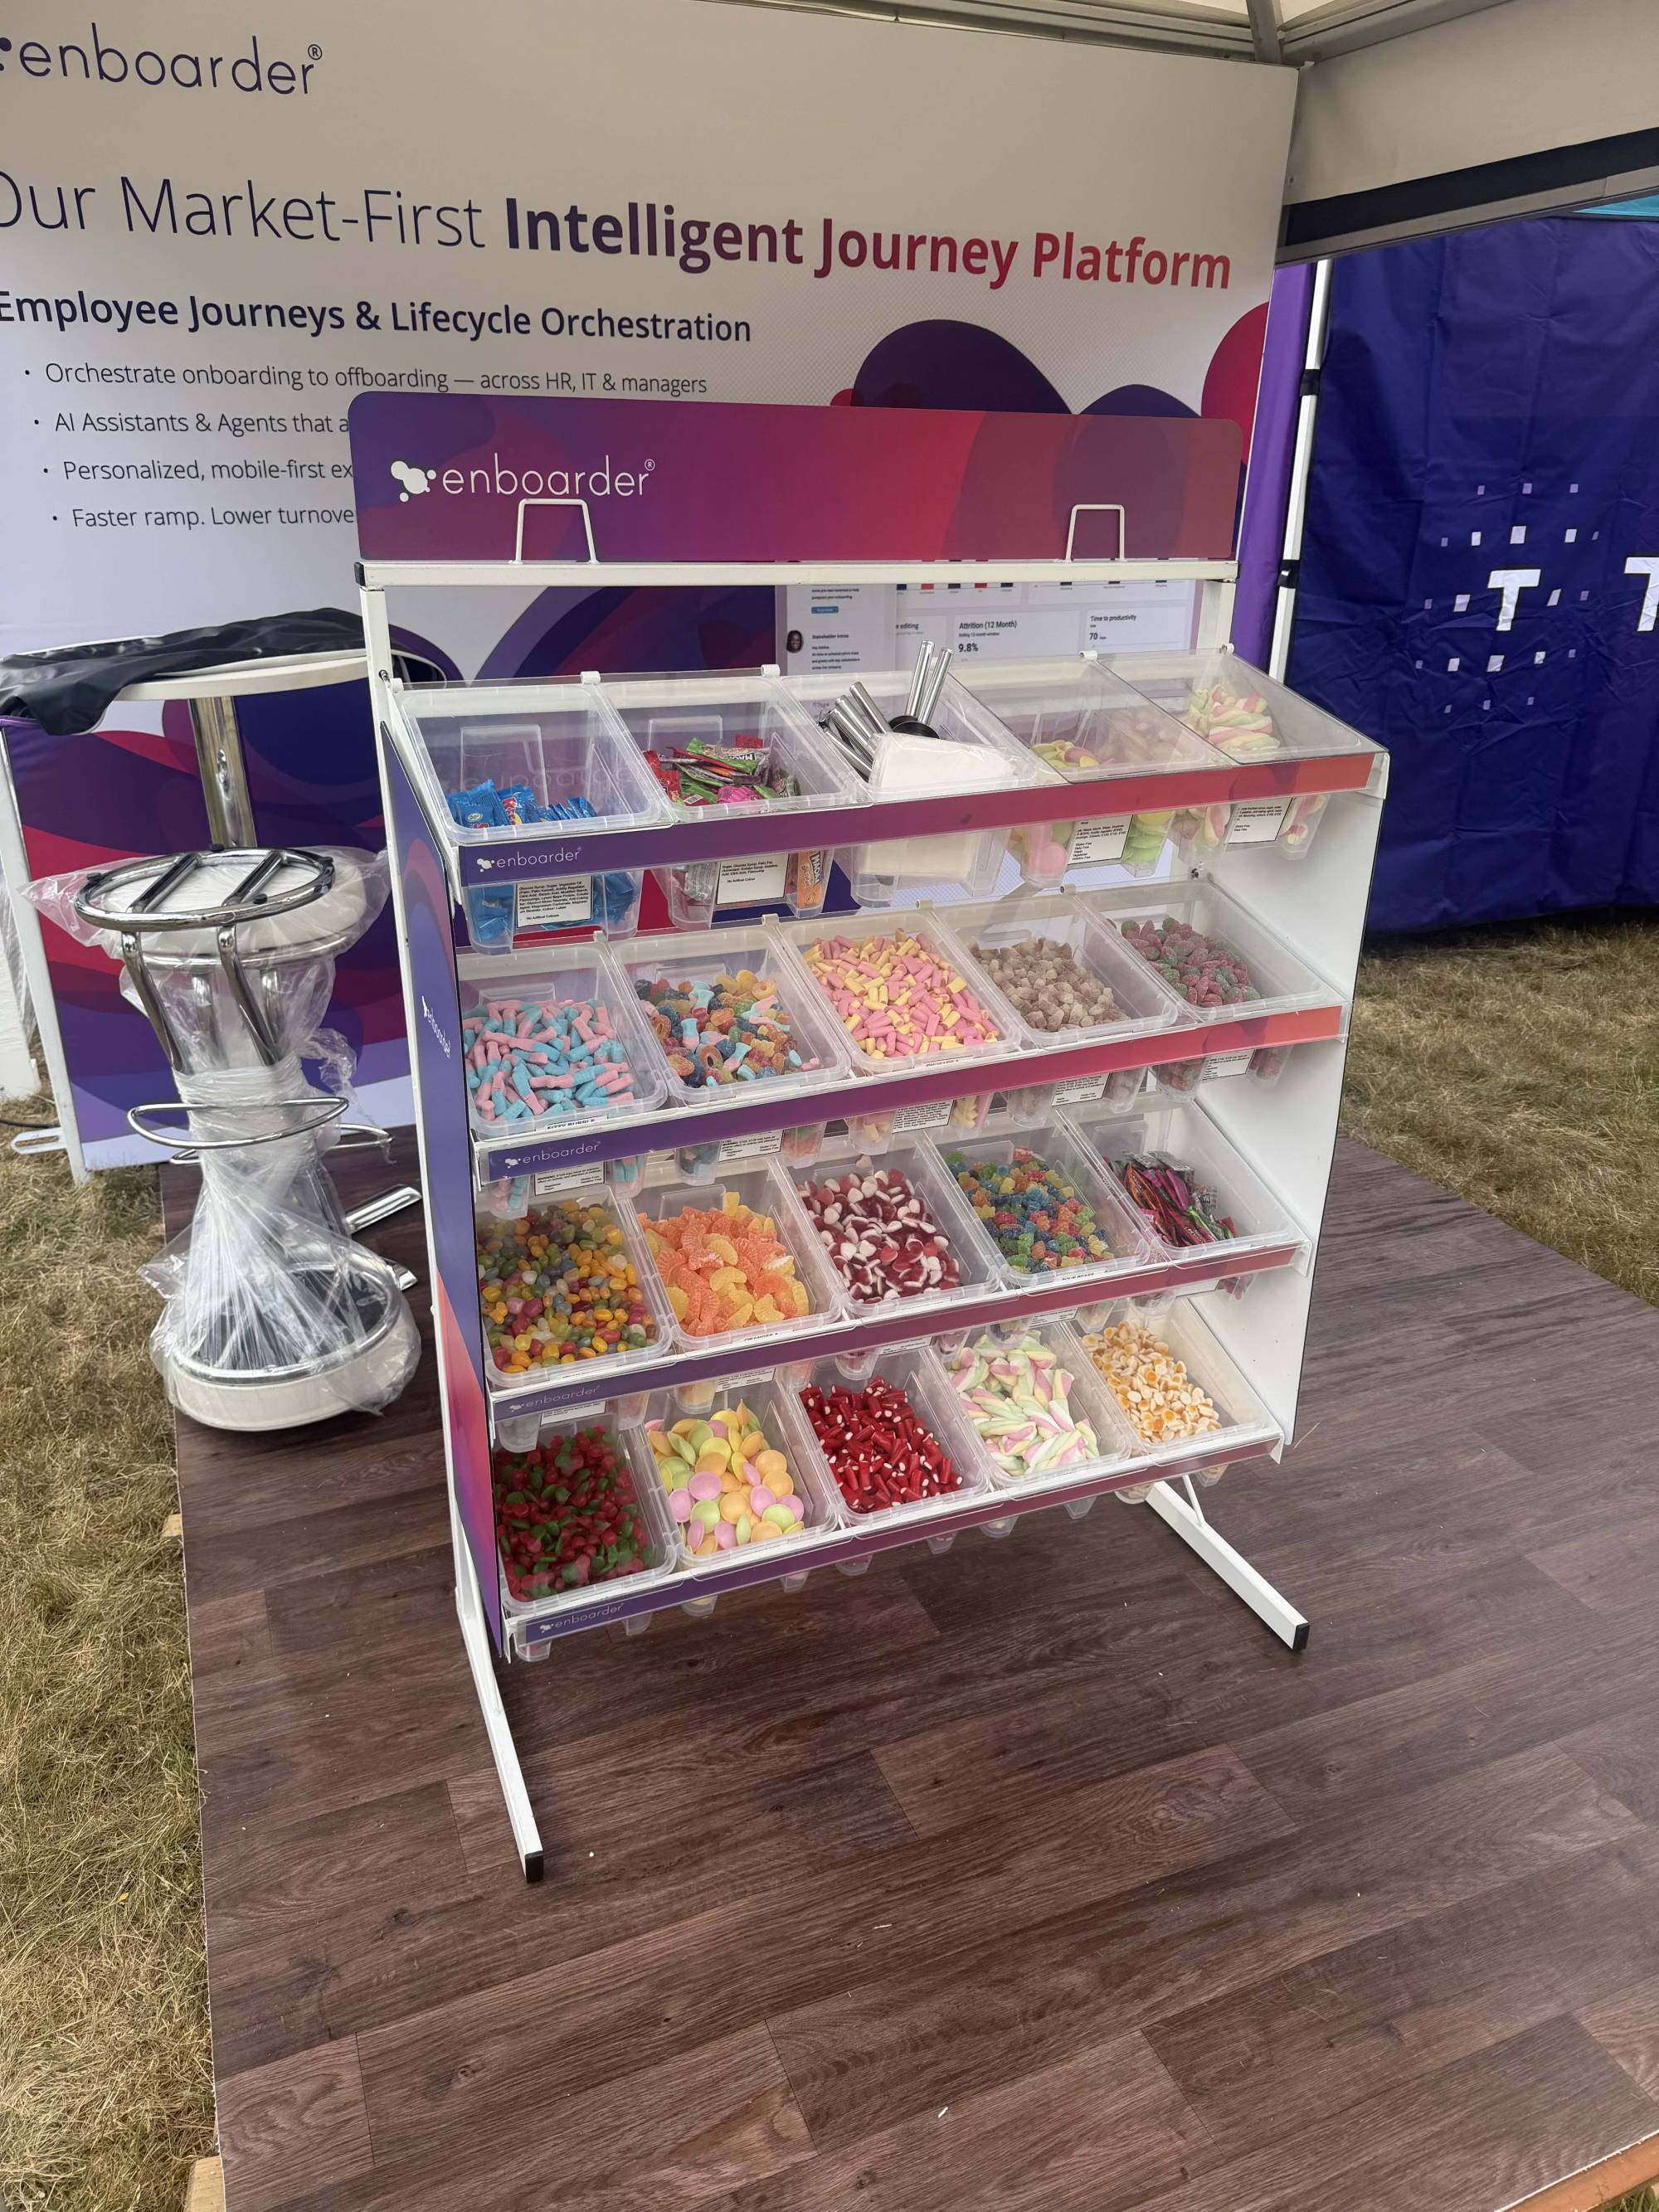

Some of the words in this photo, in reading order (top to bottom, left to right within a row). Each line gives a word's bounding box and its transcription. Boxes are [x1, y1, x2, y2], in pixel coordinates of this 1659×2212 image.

[120, 176, 487, 248] Market-First
[505, 197, 804, 275] Intelligent
[814, 217, 1019, 289] Journey
[1033, 232, 1231, 289] Platform
[0, 291, 179, 333] Employee
[188, 295, 345, 338] Journeys
[355, 300, 382, 330] &
[391, 302, 531, 341] Lifecycle
[541, 307, 752, 342] Orchestration
[46, 362, 176, 384] Orchestrate
[182, 364, 304, 391] onboarding
[308, 370, 328, 387] to
[335, 367, 449, 392] offboarding
[480, 373, 540, 390] across
[546, 372, 576, 392] HR,
[581, 373, 597, 391] IT
[602, 373, 617, 391] &
[622, 376, 708, 397] managers
[55, 413, 75, 432] AI
[82, 412, 188, 432] Assistants
[195, 414, 211, 432] &
[217, 414, 287, 437] Agents
[292, 413, 333, 433] that
[339, 418, 349, 433] a
[63, 460, 205, 482] Personalized,
[211, 460, 325, 479] mobile-first
[331, 465, 353, 479] ex
[72, 508, 137, 527] Faster
[145, 513, 205, 531] ramp.
[211, 508, 272, 526] Lower
[278, 508, 354, 525] turnove
[1487, 569, 1541, 631] T
[985, 621, 995, 631] (12
[996, 620, 1017, 630] Month)
[958, 643, 979, 653] 9.8%
